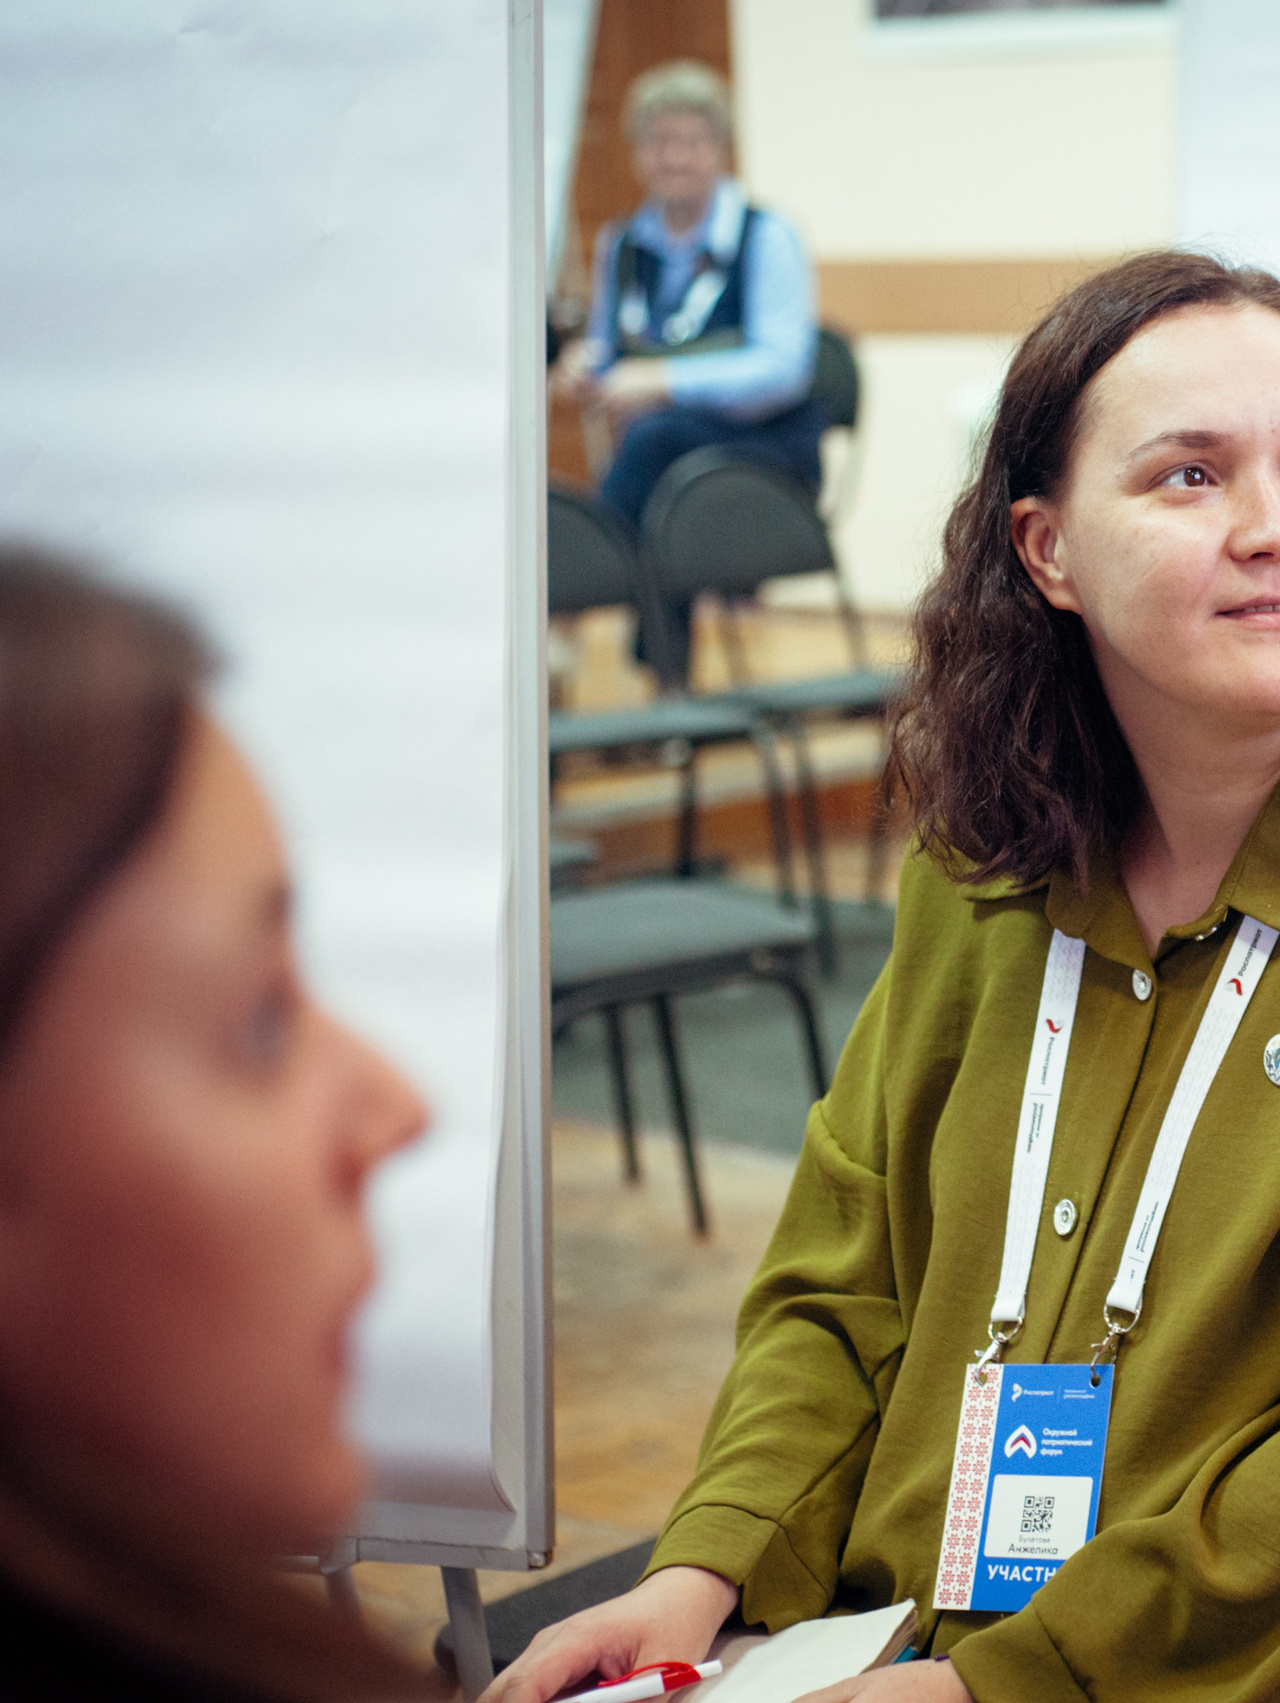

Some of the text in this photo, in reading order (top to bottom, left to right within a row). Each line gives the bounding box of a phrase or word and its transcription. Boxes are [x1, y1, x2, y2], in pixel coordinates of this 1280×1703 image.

[1238, 928, 1262, 977] Роспатриот
[1008, 1543, 1058, 1555] Анжелика
[987, 1564, 1057, 1582] УЧАСТН
